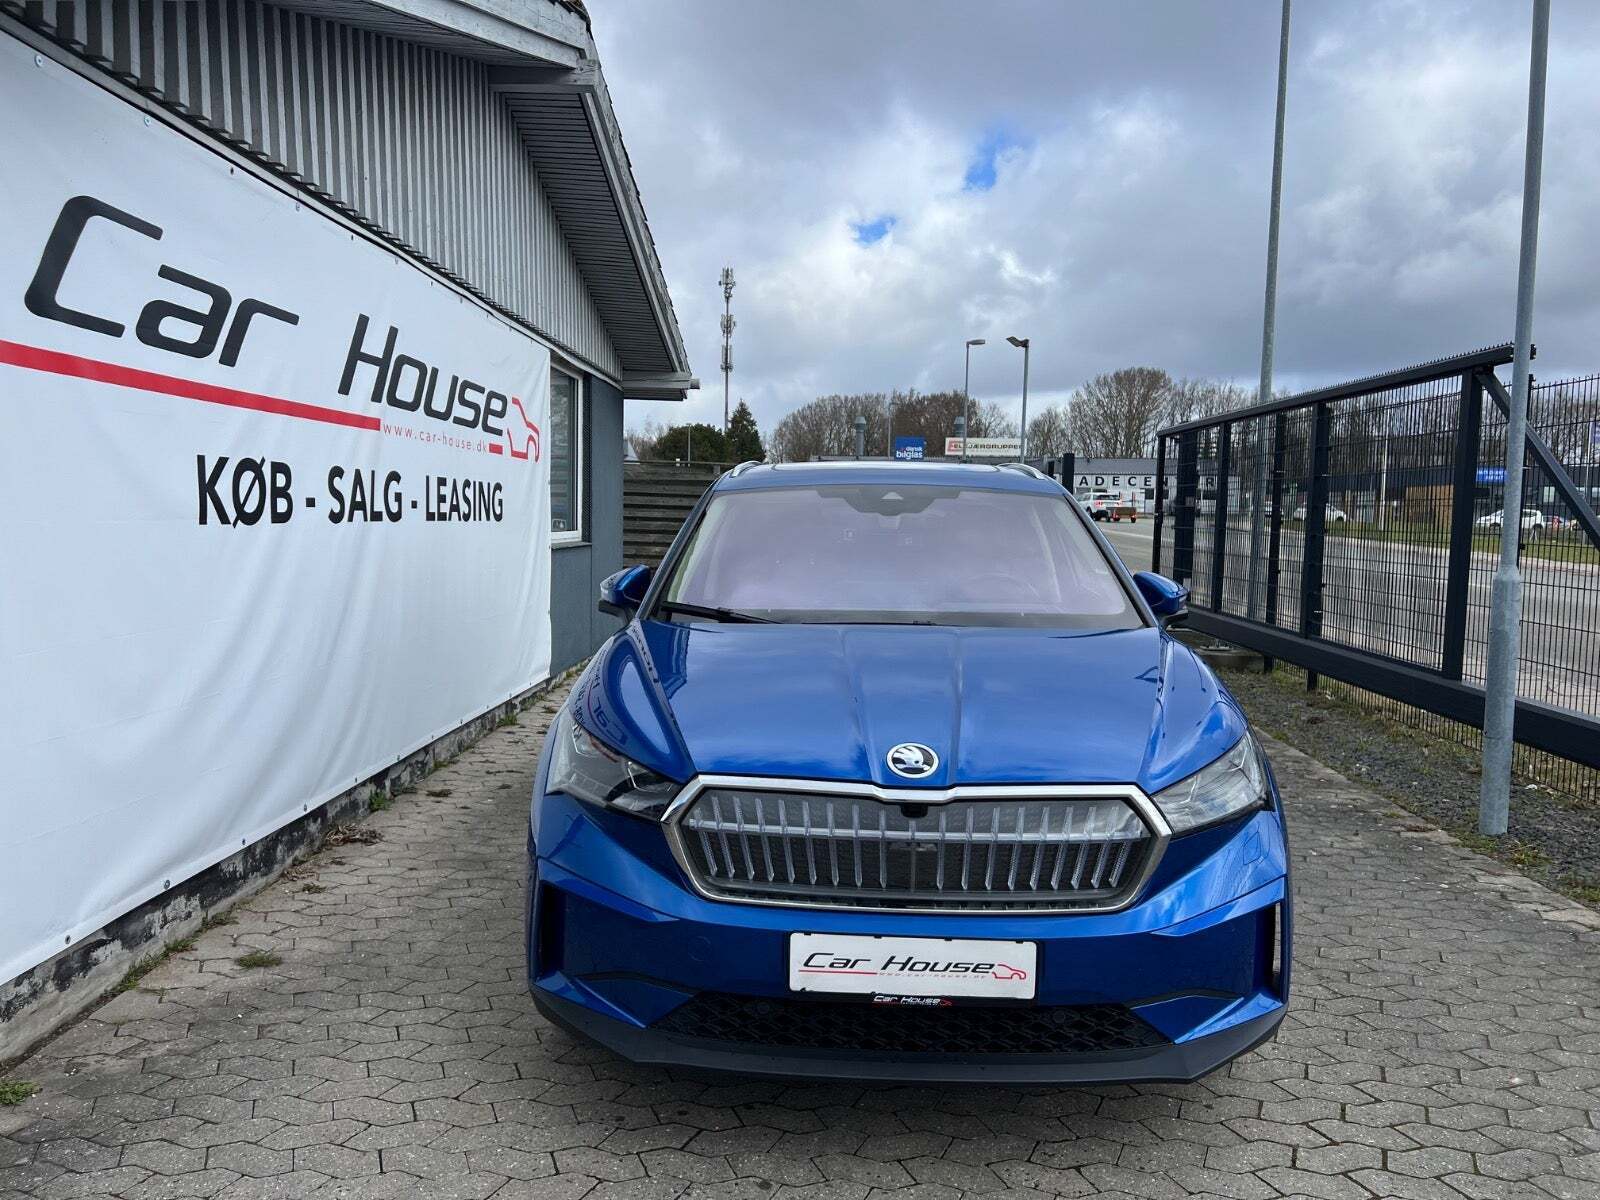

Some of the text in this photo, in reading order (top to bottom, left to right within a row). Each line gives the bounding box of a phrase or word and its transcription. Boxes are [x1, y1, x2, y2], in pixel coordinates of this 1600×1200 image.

[24, 195, 507, 436] Car House
[383, 423, 487, 453] www.car-house.dk
[896, 450, 923, 460] bilglas
[197, 455, 293, 528] KØB
[328, 465, 402, 524] SALG
[425, 475, 503, 522] LEASING
[803, 952, 996, 974] Car House
[873, 995, 941, 1006] Car House
